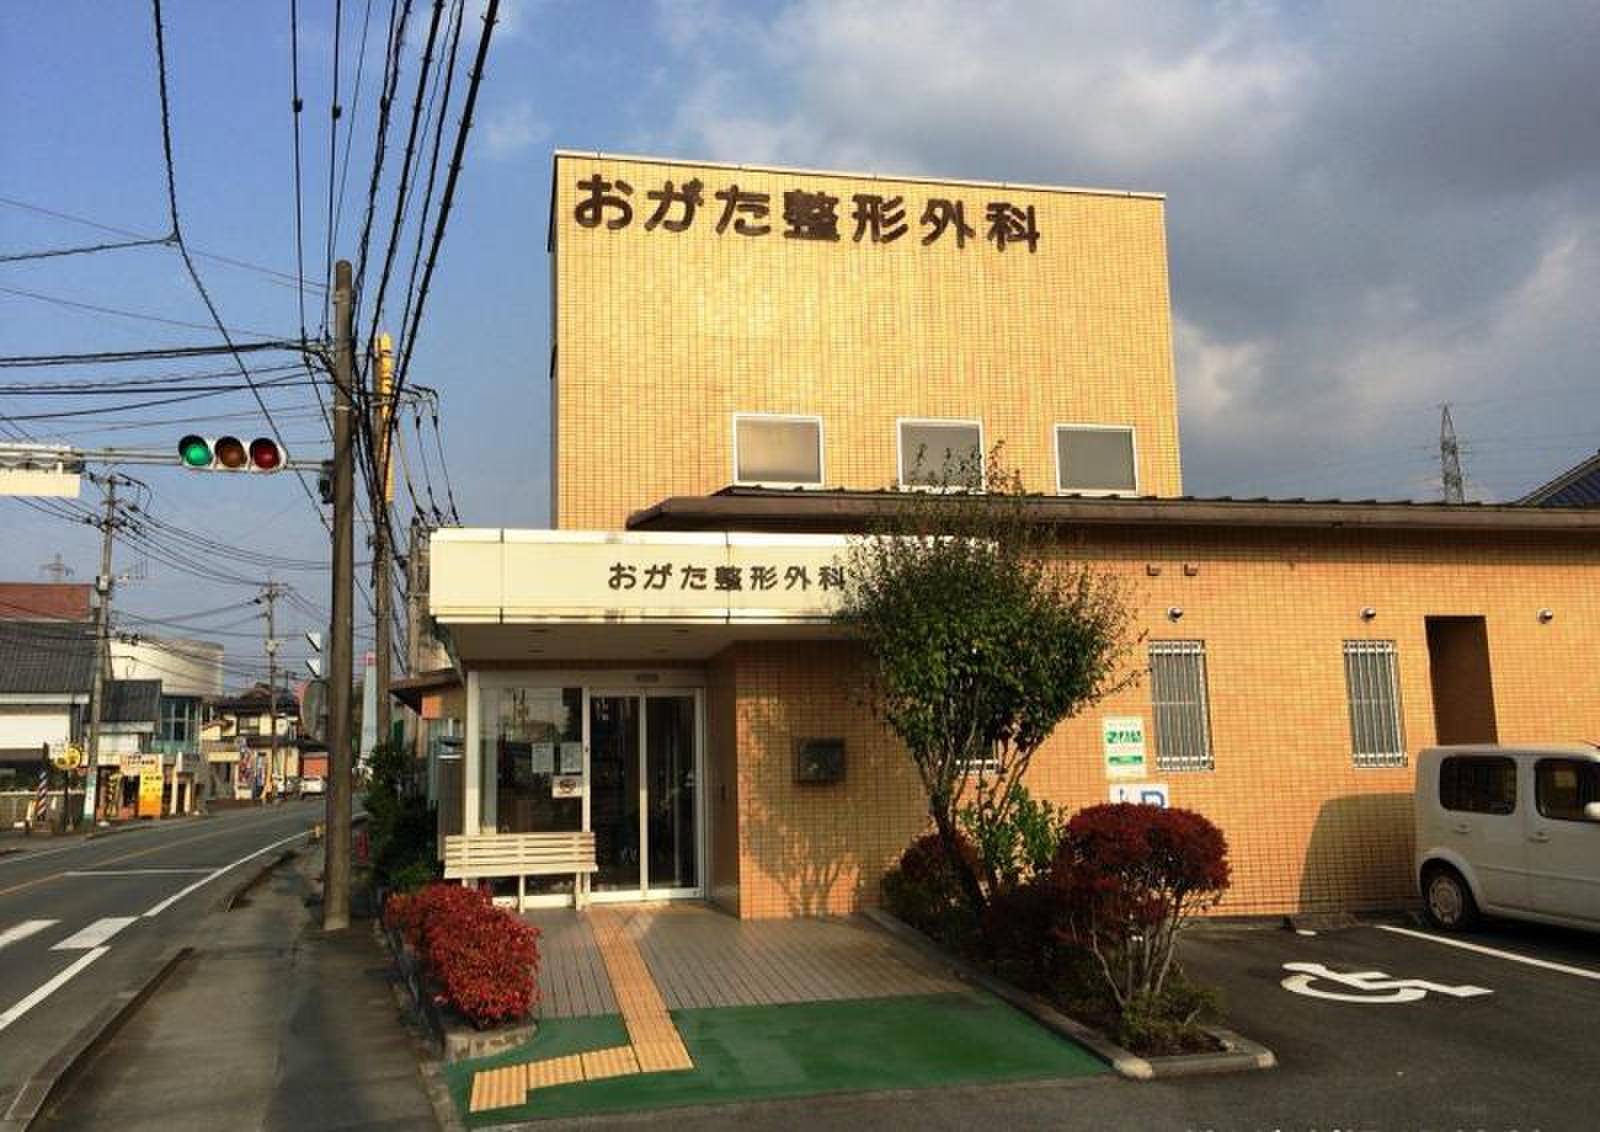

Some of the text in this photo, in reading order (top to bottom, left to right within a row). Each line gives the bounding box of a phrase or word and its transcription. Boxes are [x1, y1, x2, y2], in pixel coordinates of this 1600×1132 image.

[574, 174, 1040, 253] おがた整形外科
[608, 562, 846, 591] おがた整形外科
